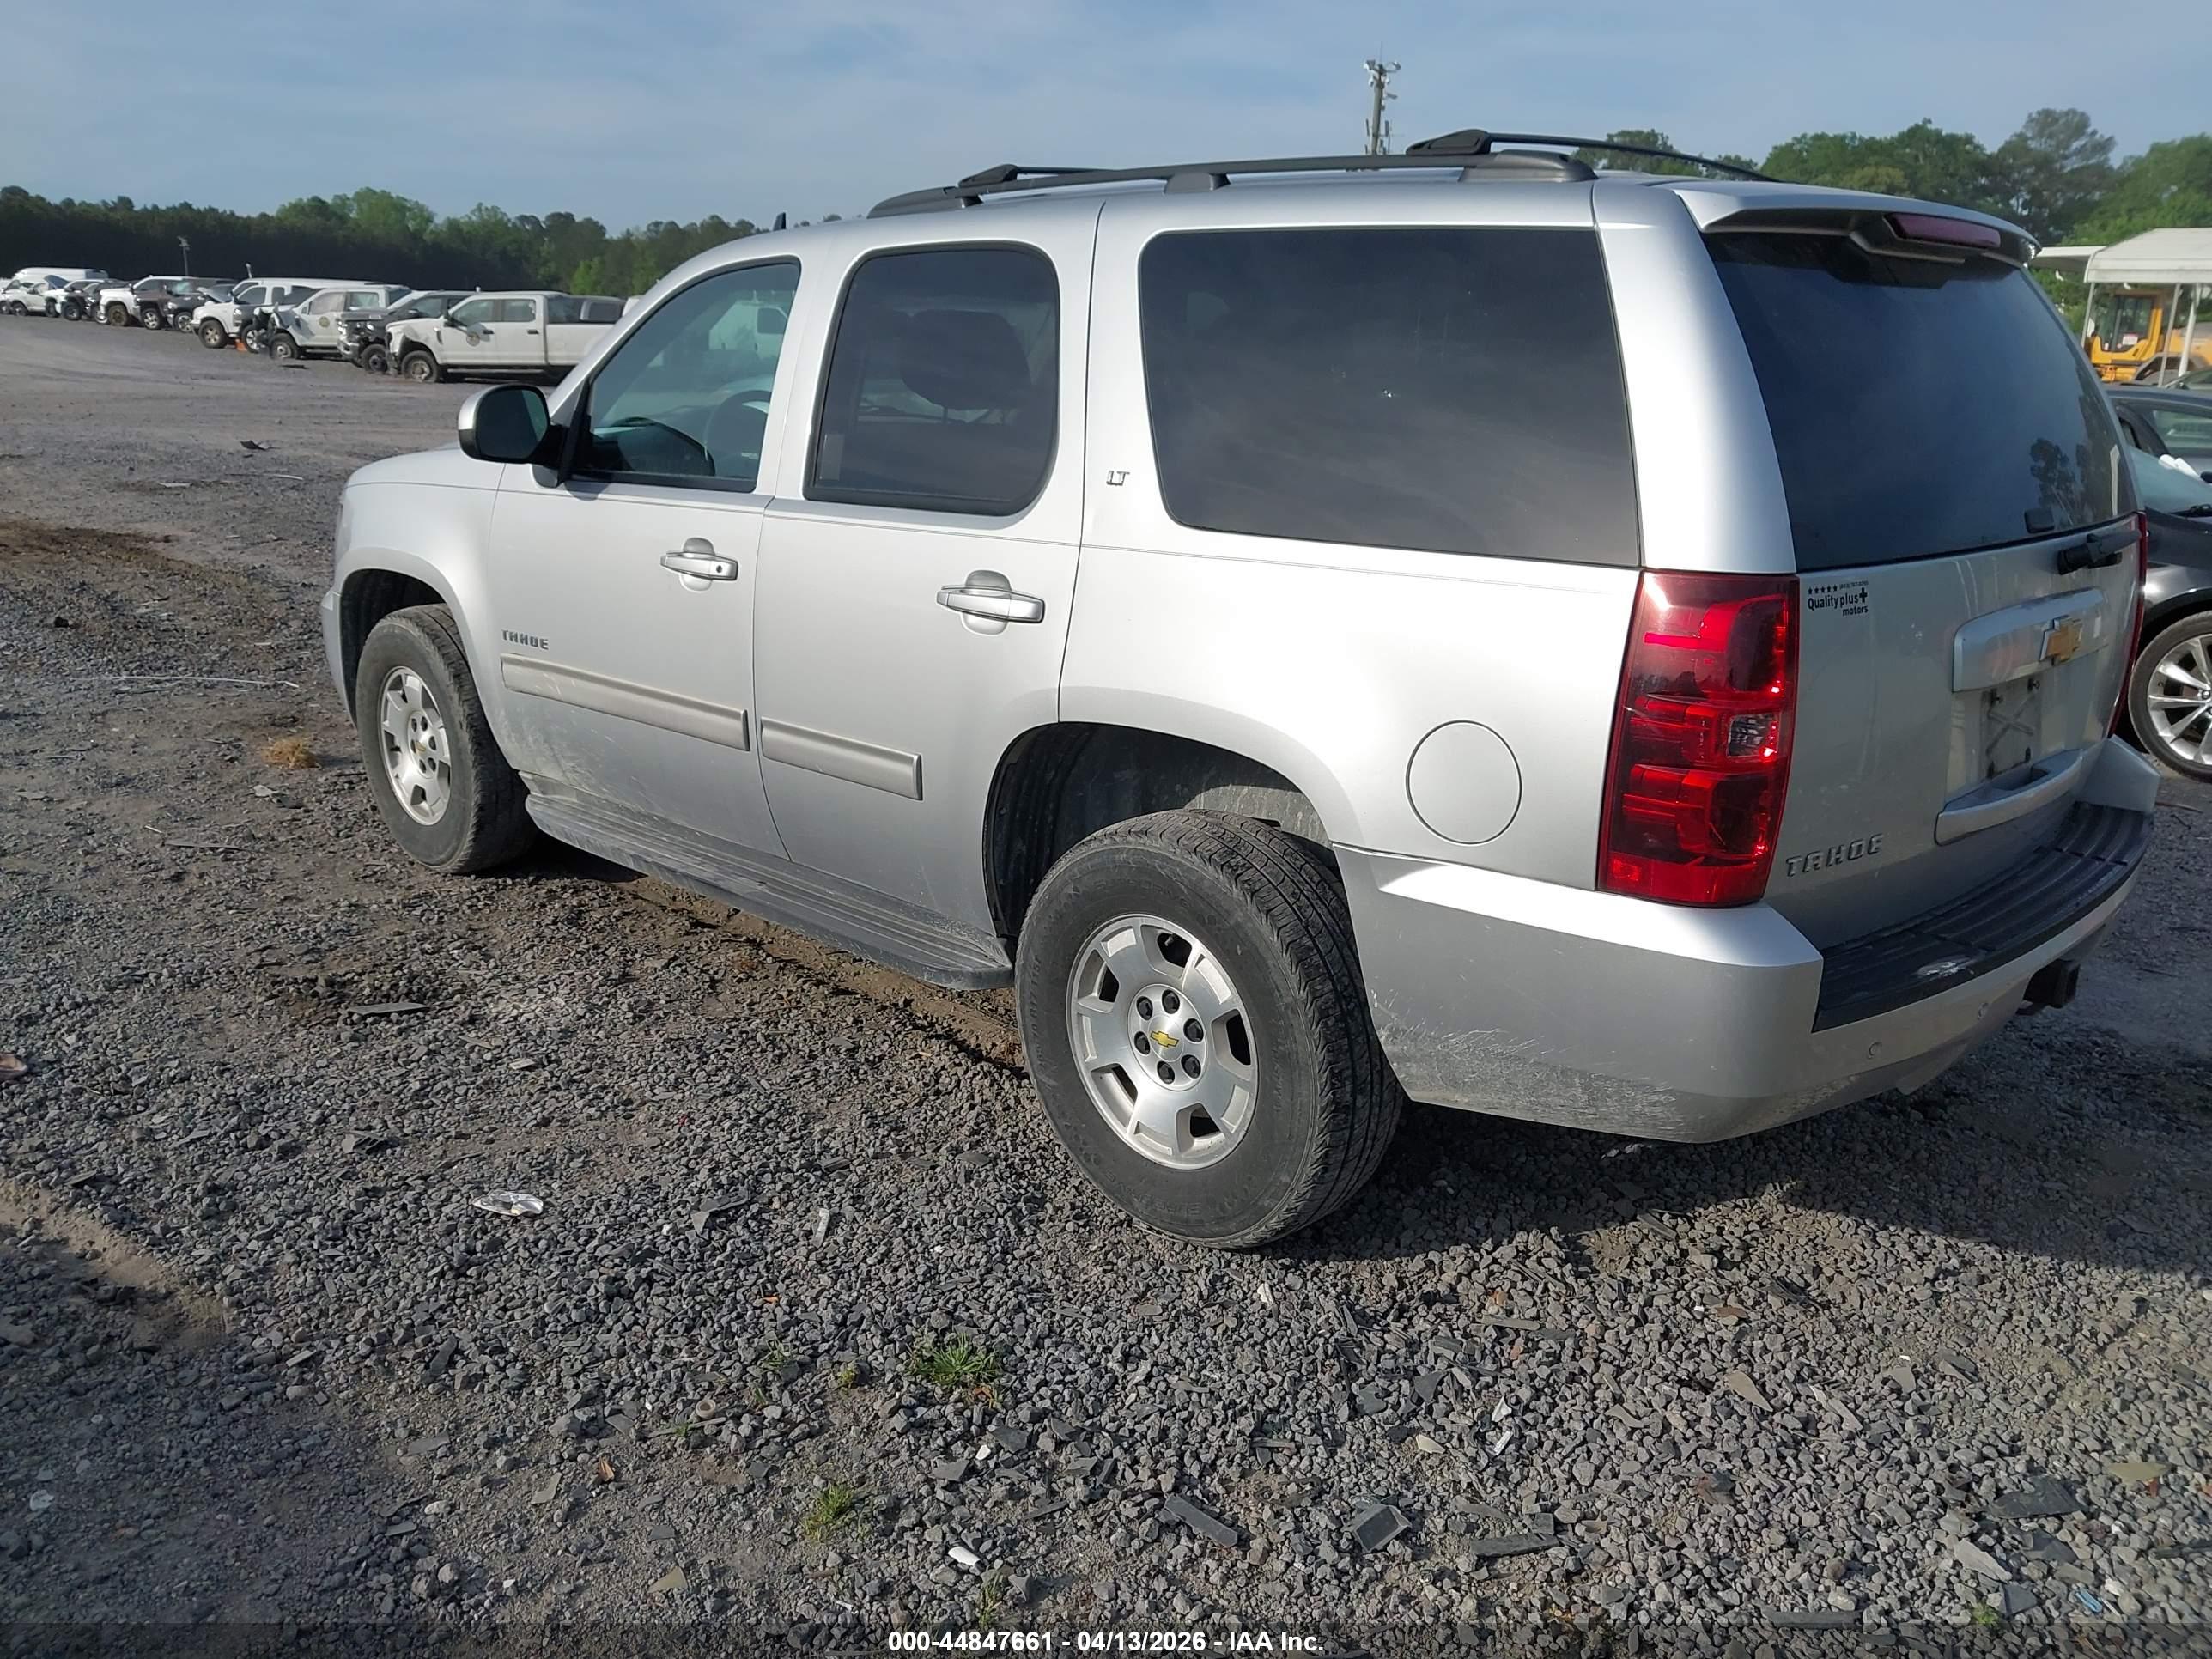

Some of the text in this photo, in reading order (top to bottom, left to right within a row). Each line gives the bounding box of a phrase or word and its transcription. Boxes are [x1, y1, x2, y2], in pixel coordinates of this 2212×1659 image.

[1106, 470, 1131, 487] LT
[1808, 595, 1838, 611] Quality
[1842, 605, 1869, 617] motors
[501, 629, 550, 651] TAHOE
[1785, 833, 1885, 878] TAHOE
